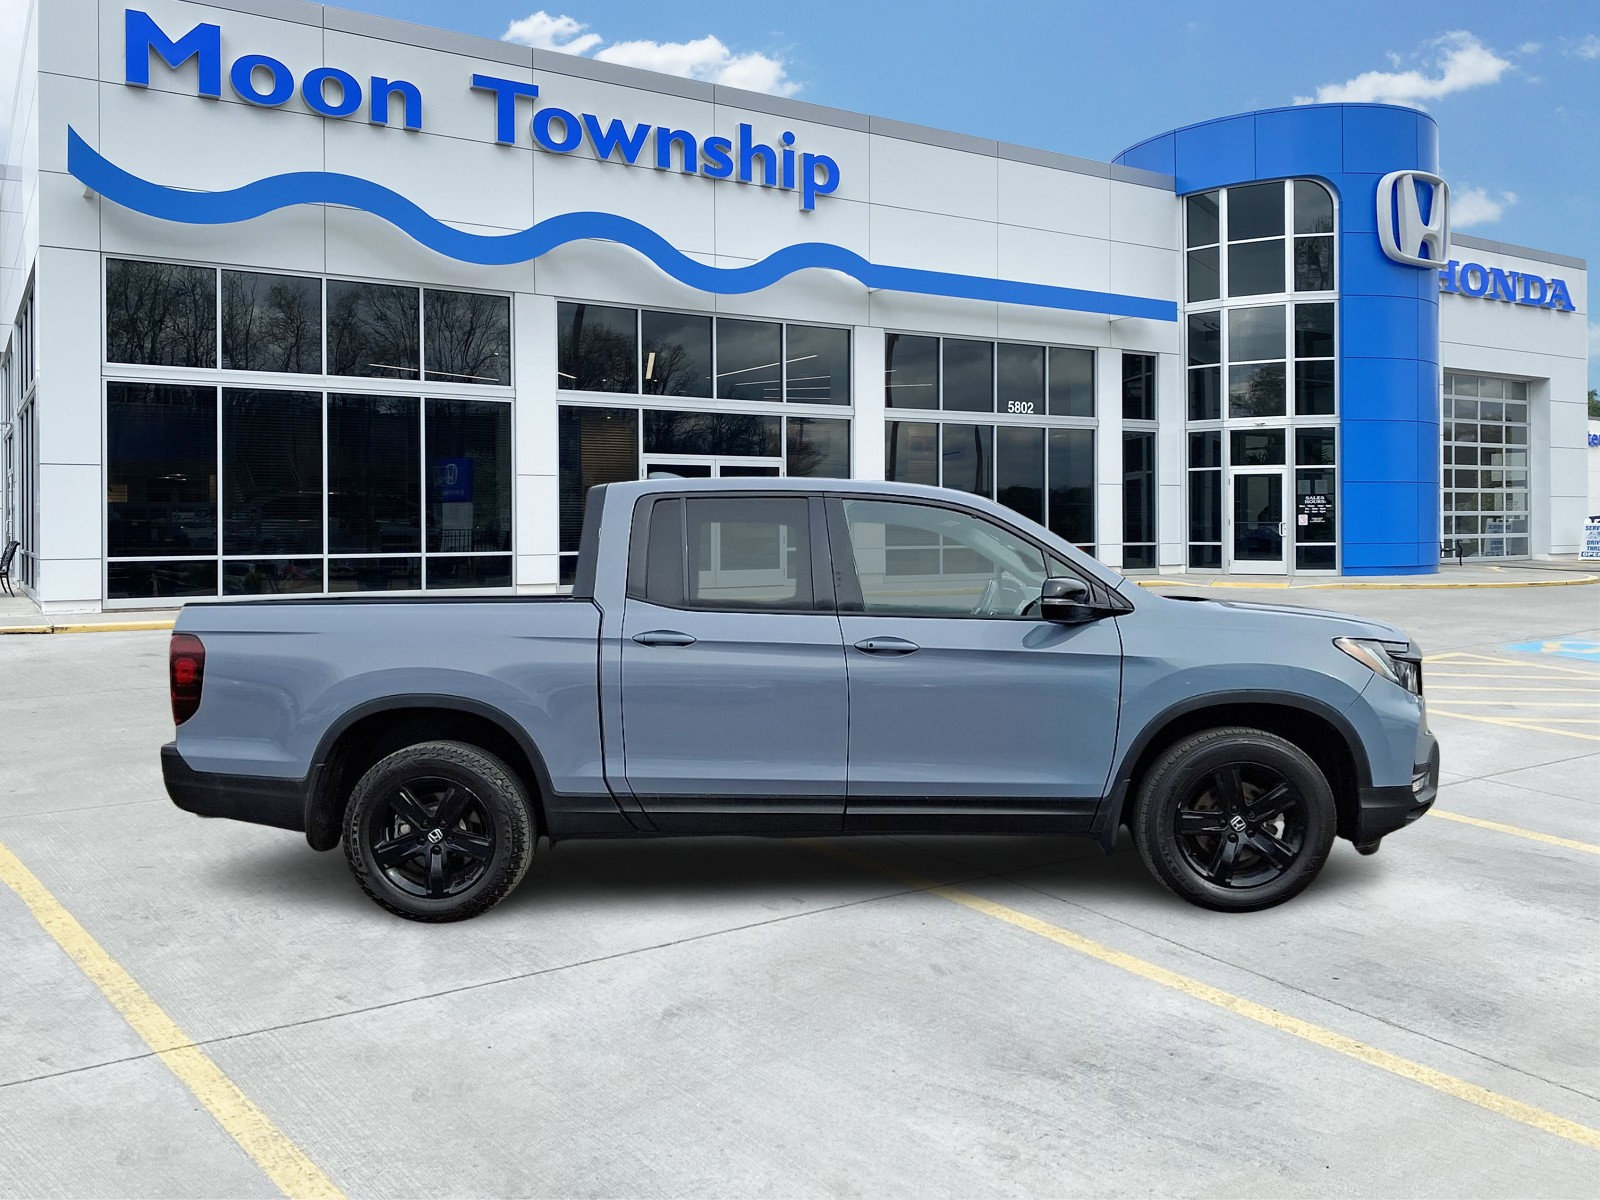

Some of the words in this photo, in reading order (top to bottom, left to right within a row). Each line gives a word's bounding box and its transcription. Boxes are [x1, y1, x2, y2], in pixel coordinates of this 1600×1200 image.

[125, 10, 422, 130] Moon
[472, 74, 841, 211] Township
[1007, 400, 1034, 414] 5802
